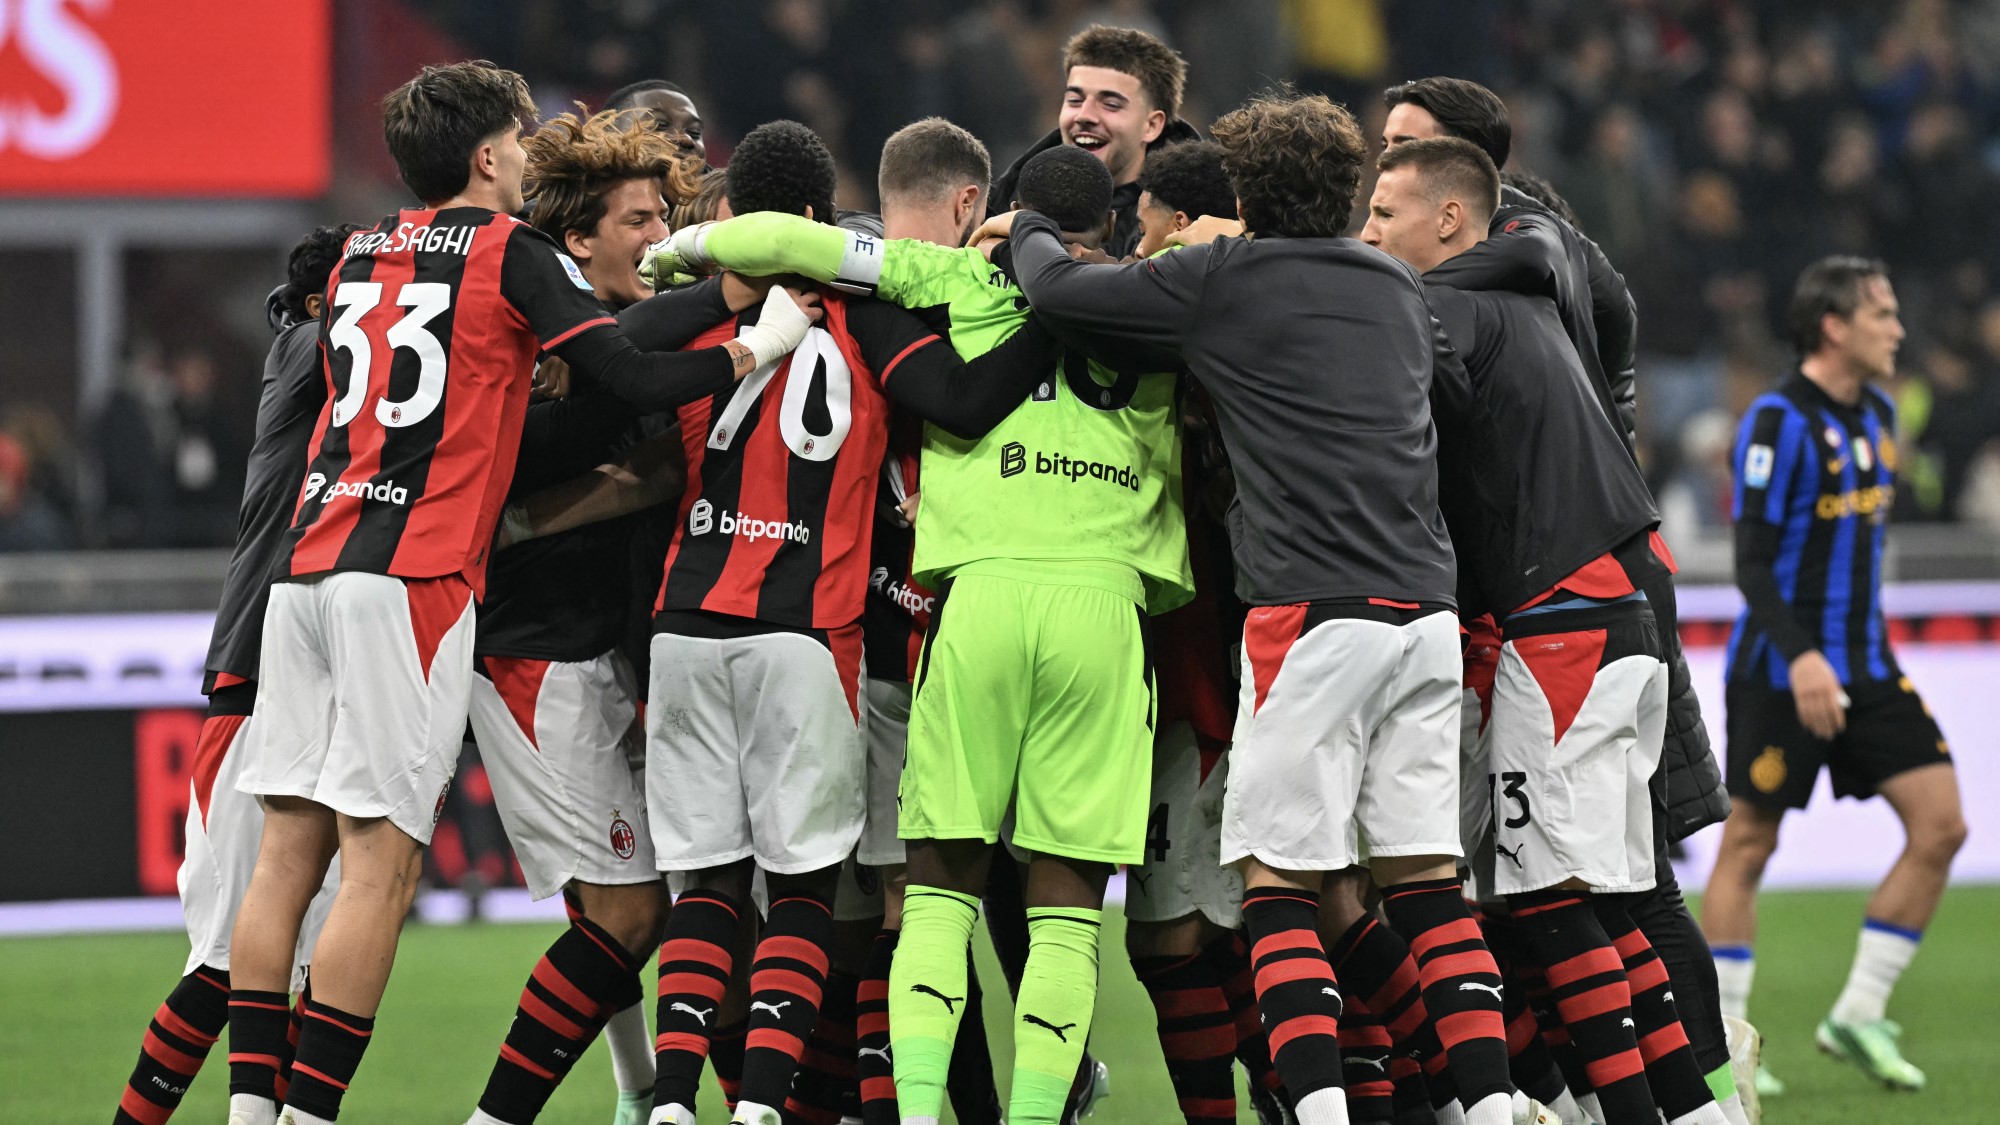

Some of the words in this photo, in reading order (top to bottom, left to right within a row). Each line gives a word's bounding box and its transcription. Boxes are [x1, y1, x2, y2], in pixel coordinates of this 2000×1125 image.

[343, 222, 477, 260] BARESAGHI
[329, 281, 451, 428] 33
[1035, 451, 1140, 492] bitpanda
[719, 509, 810, 545] bitpanda
[1488, 771, 1531, 833] 13
